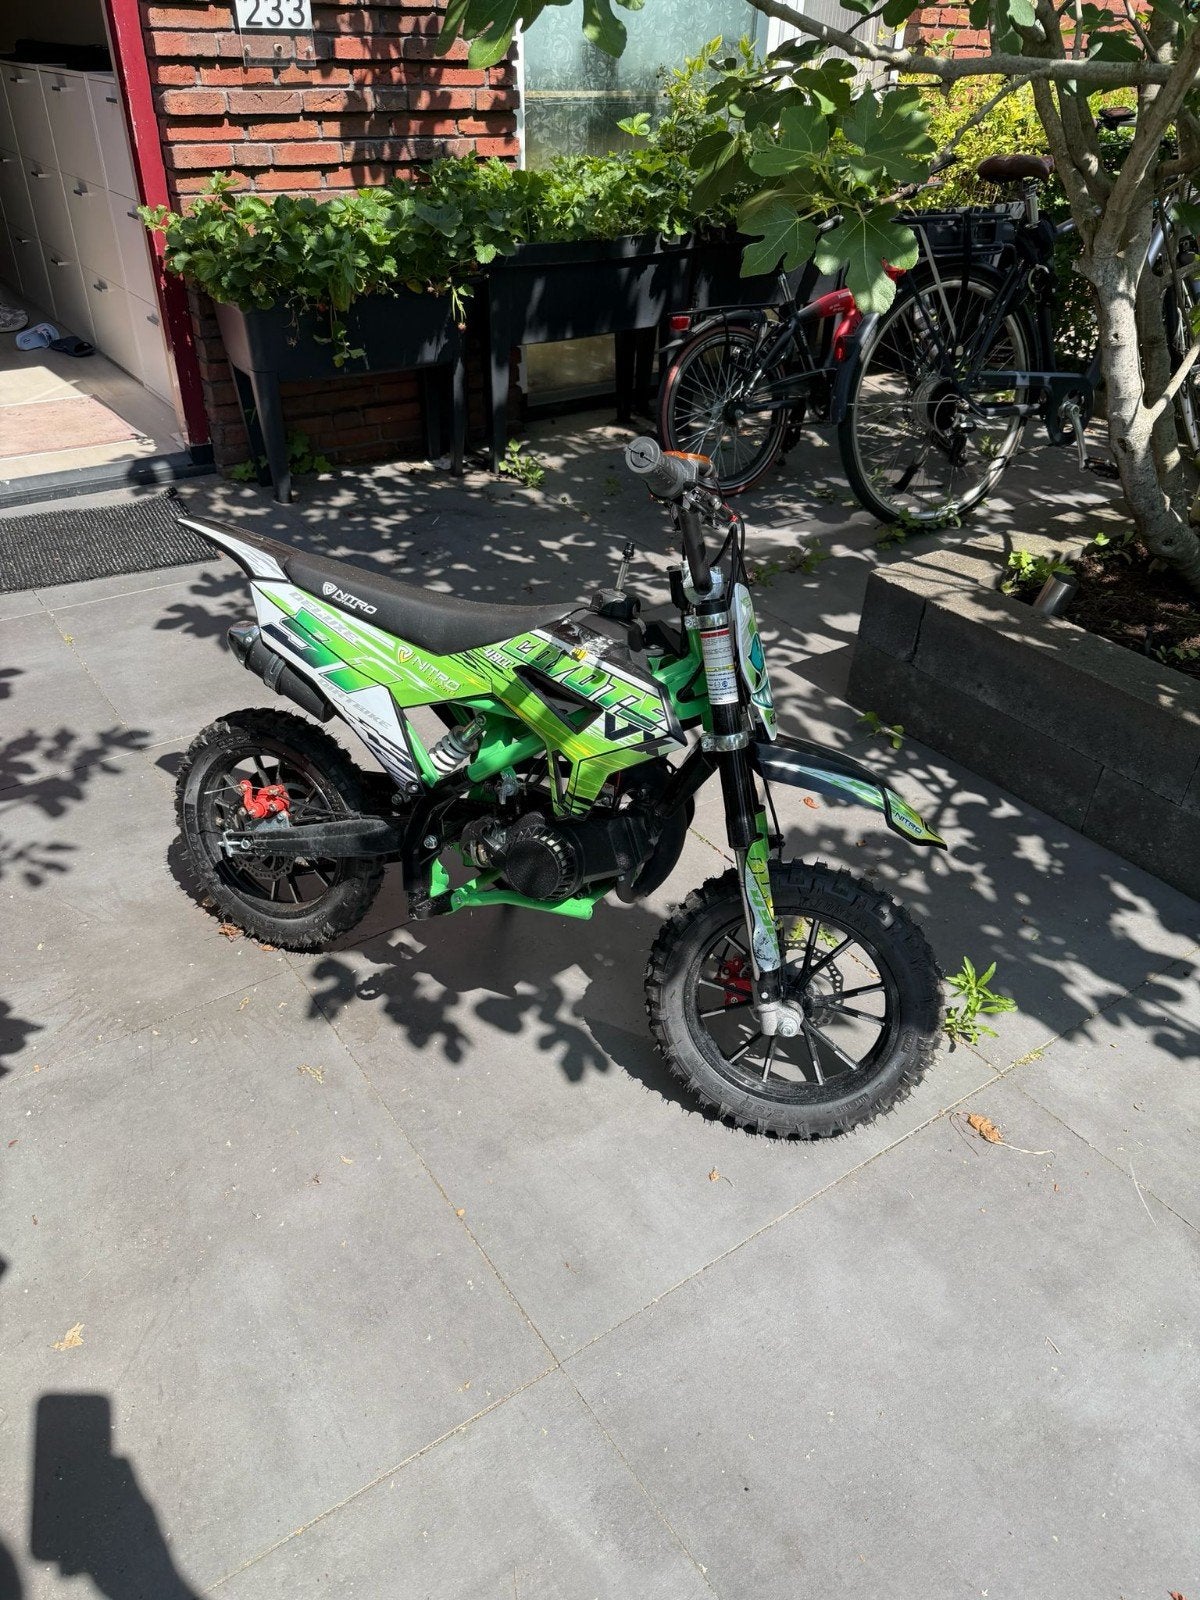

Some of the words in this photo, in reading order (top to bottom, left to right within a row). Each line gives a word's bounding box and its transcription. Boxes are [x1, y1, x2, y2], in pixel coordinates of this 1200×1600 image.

[245, 0, 305, 27] 233
[332, 589, 378, 615] NITRO
[288, 591, 359, 642] DELUXE
[412, 655, 461, 692] NITRO
[895, 812, 923, 834] NITRO
